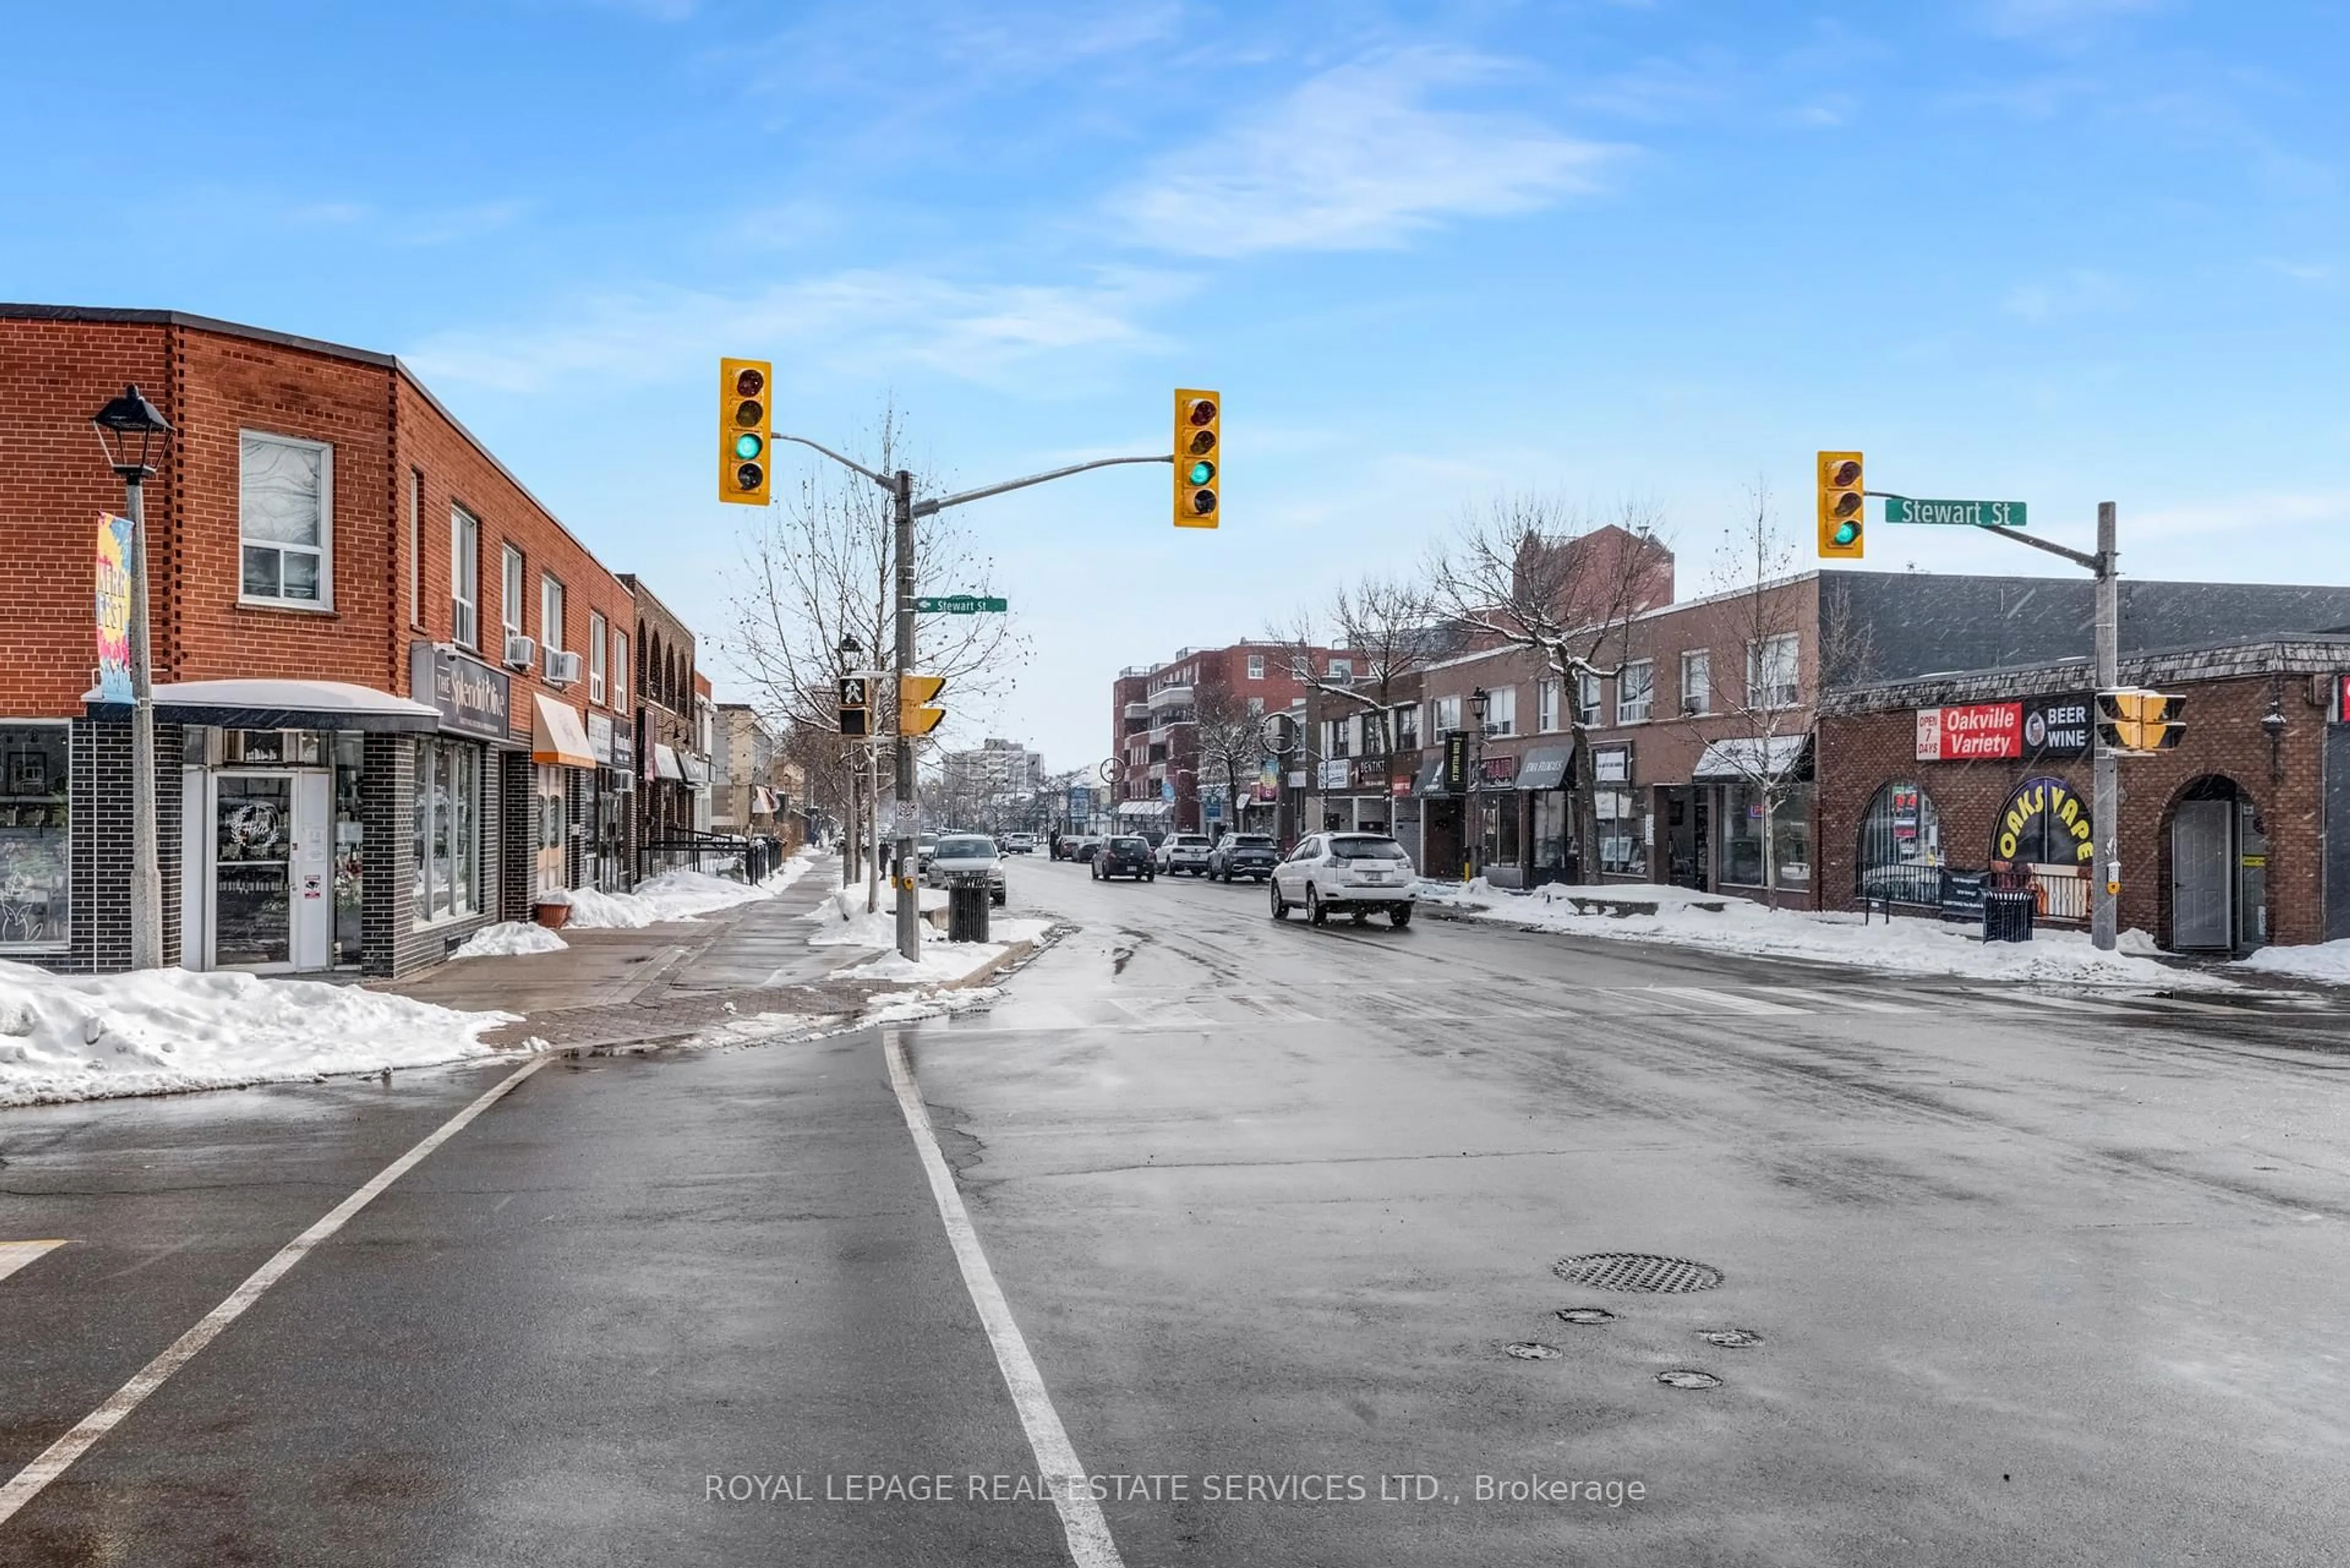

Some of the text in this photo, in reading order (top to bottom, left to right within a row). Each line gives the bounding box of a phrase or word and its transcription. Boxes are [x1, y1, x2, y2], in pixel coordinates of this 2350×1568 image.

[1901, 500, 2010, 525] Stewart St
[97, 594, 126, 630] FEST
[937, 600, 987, 611] Stewart St
[437, 674, 450, 694] THE
[1919, 715, 1938, 728] OPEN
[1947, 707, 2015, 731] Oakville
[2048, 706, 2086, 725] BEER
[1925, 728, 1931, 741] 7
[2047, 730, 2086, 747] WINE
[1919, 742, 1938, 755] DAYS
[1951, 734, 2011, 756] Variety
[1360, 760, 1386, 774] DENTIST
[2000, 785, 2094, 861] OAKS VAPE
